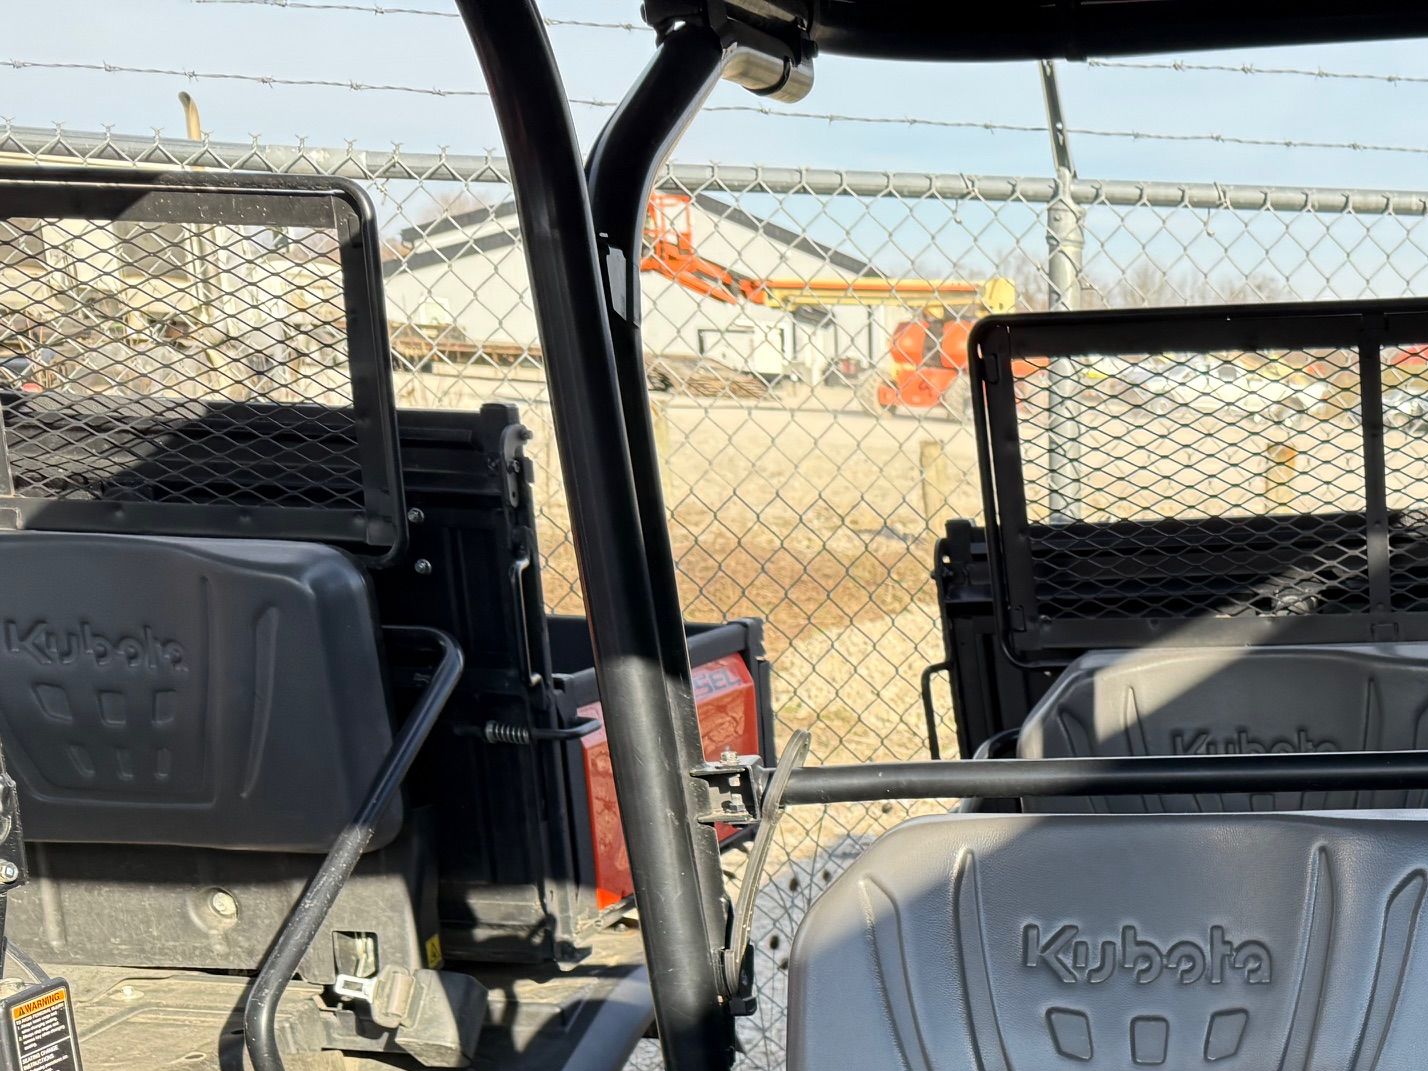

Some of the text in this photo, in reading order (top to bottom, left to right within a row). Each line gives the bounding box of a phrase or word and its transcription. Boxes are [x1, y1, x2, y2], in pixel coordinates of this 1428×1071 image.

[2, 619, 188, 672] Kubota
[1021, 922, 1276, 987] Kubota
[25, 993, 60, 1014] WARNING
